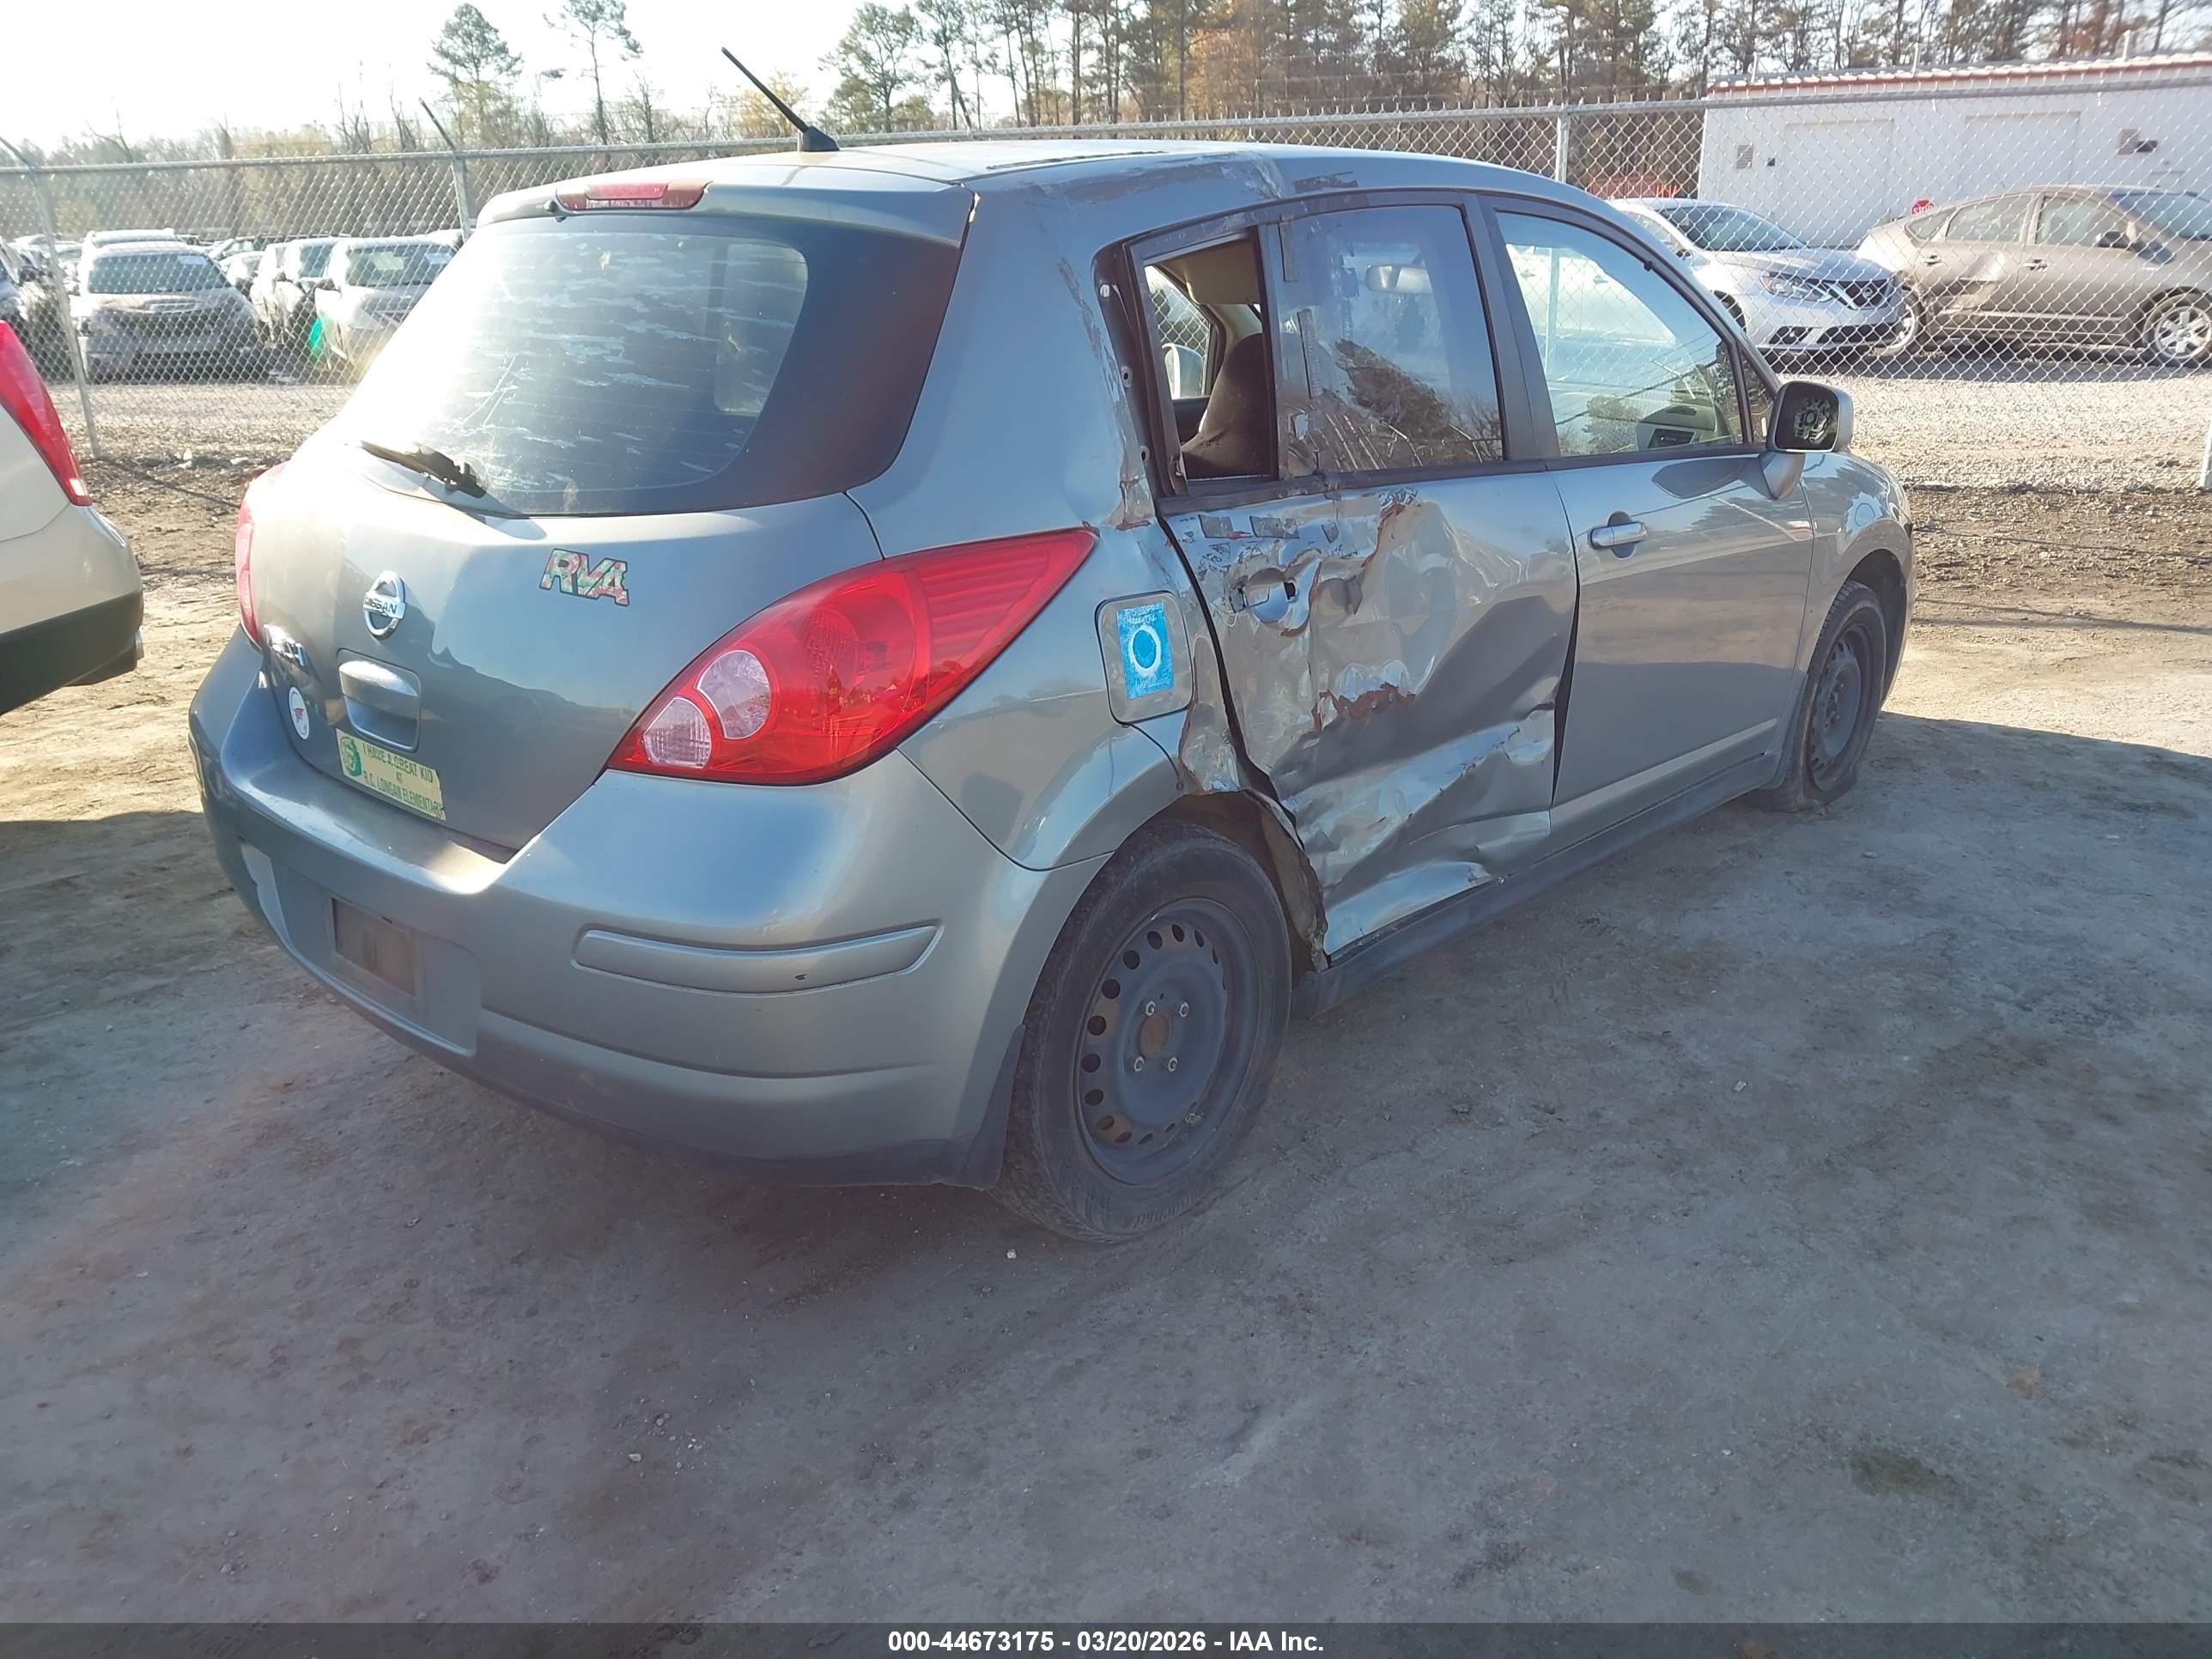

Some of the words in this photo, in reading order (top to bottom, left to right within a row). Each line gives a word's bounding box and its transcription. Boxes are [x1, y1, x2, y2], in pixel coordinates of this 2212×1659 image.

[539, 548, 629, 606] RVA
[368, 745, 386, 764] HAVE
[387, 755, 392, 766] A
[394, 754, 417, 776] GREAT
[419, 765, 434, 783] KID
[396, 772, 403, 783] AT
